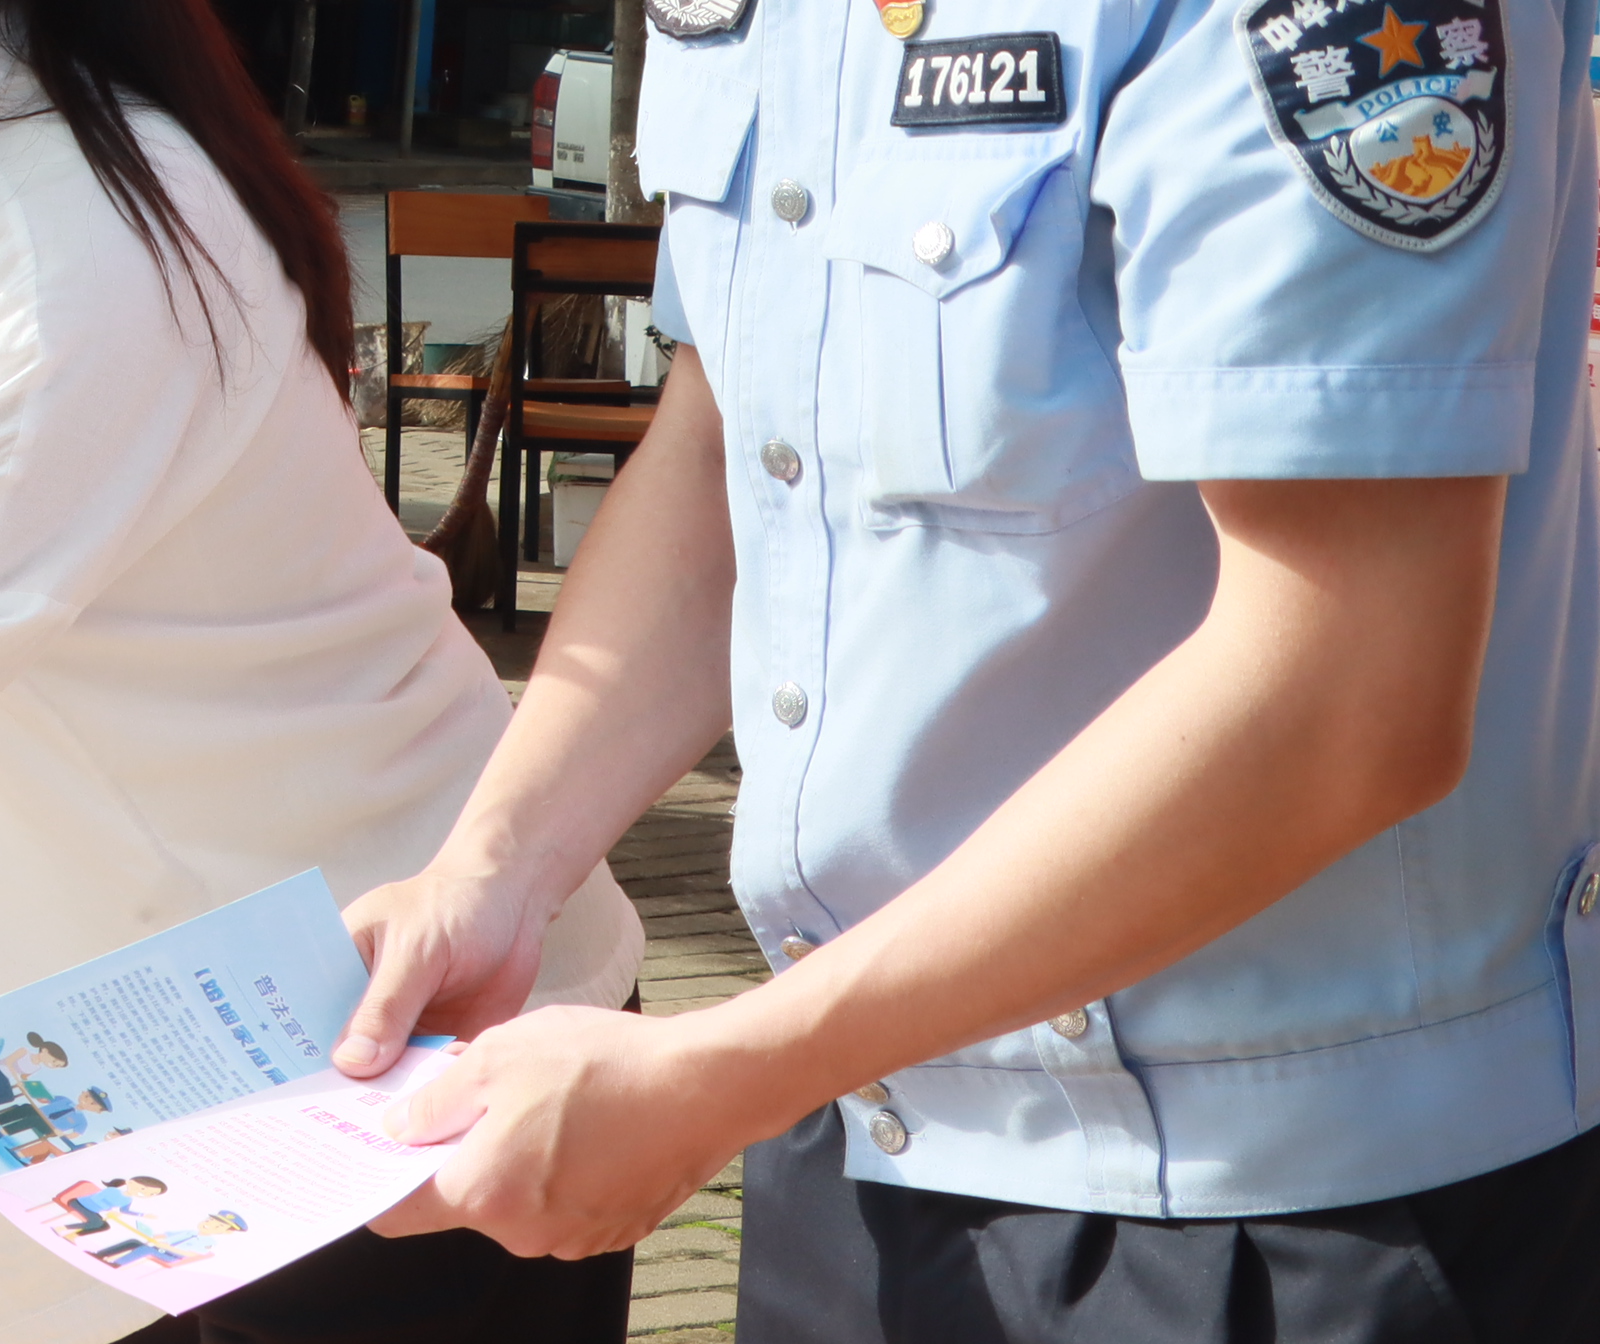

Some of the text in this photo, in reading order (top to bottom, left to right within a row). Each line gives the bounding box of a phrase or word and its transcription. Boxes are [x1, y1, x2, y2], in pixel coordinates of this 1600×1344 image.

[903, 49, 1046, 108] 176121
[1355, 75, 1465, 121] POLICE
[254, 974, 322, 1058] 普法宣传
